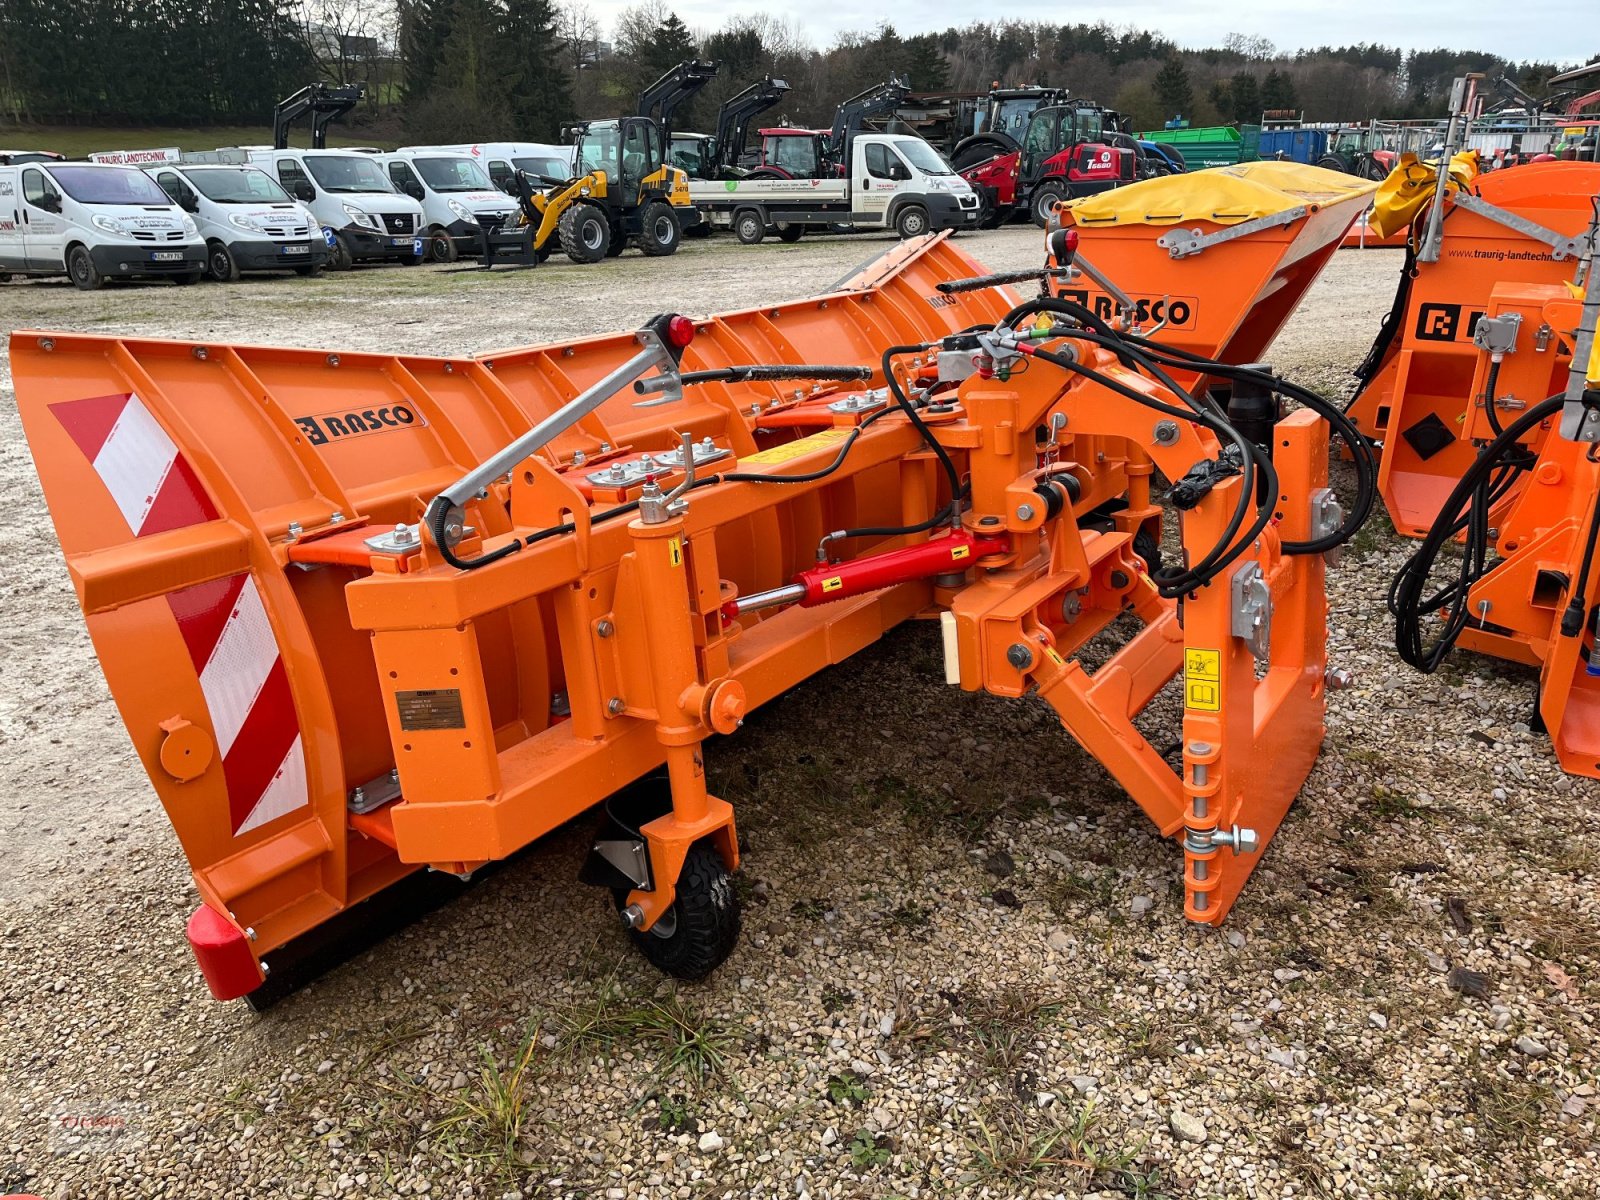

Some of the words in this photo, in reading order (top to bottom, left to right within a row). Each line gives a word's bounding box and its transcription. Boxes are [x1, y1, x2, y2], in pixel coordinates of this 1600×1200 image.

[123, 151, 166, 163] LANDTECHNIK
[323, 229, 335, 244] P
[414, 240, 422, 252] P
[322, 405, 414, 437] RASCO
